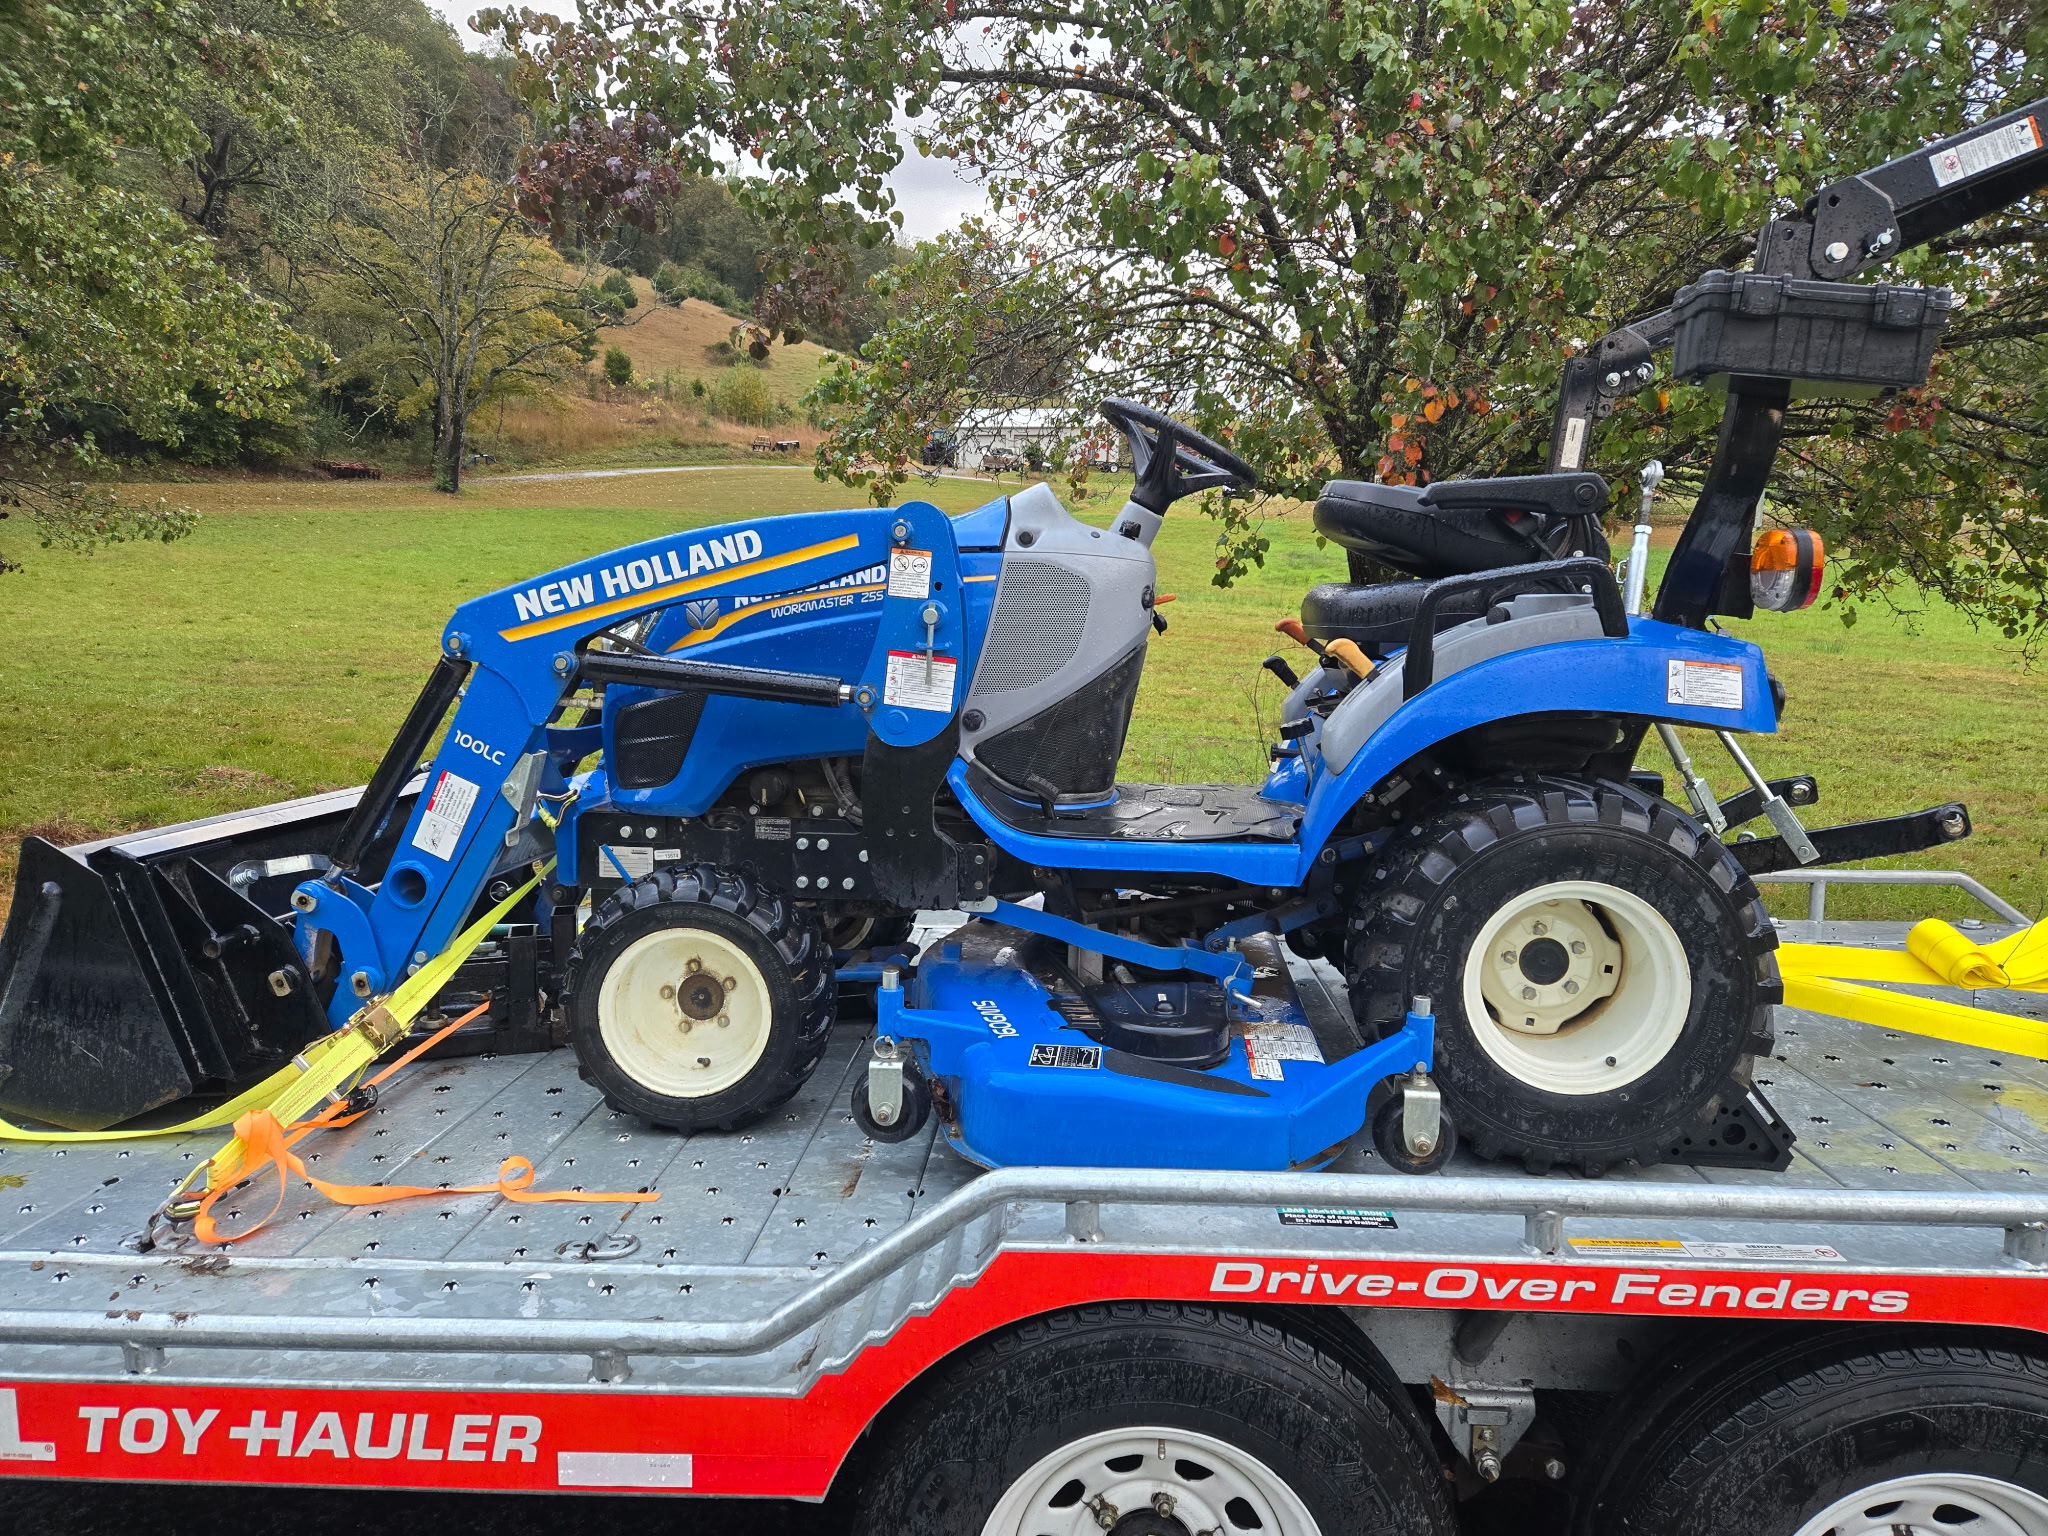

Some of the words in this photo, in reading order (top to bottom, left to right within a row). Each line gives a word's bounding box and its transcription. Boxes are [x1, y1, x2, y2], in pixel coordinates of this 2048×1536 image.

[513, 573, 595, 621] NEW
[599, 529, 763, 597] HOLLAND
[770, 594, 853, 618] WORKMASTER
[860, 591, 884, 603] 25S
[454, 729, 507, 766] 100LC
[972, 1000, 1020, 1039] 160GMS
[1209, 1262, 1596, 1302] Drive-Over
[1610, 1273, 1910, 1314] Fenders
